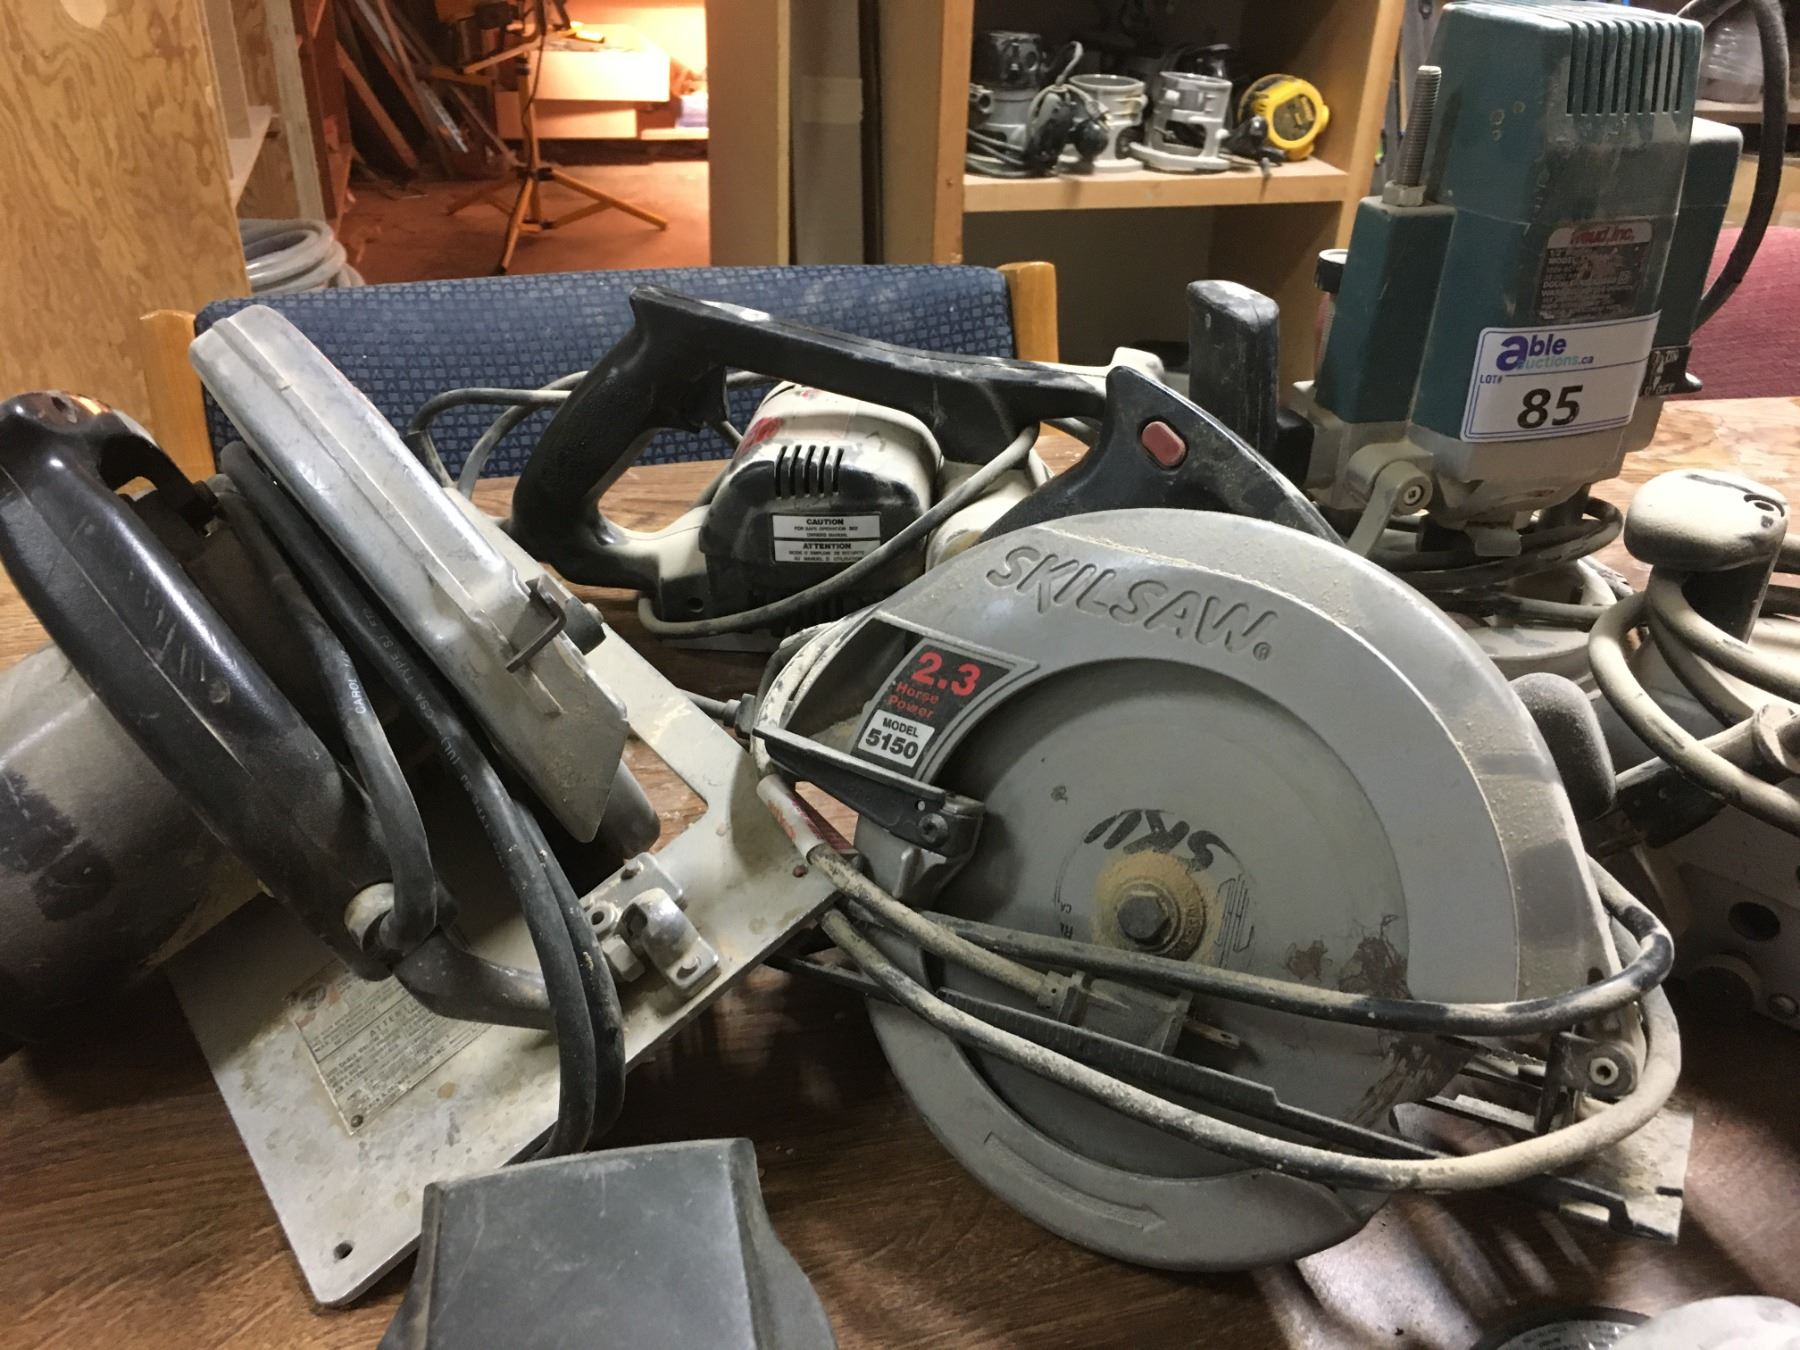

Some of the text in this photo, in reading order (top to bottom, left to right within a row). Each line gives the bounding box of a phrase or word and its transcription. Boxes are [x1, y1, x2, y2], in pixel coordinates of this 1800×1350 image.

[1496, 335, 1567, 371] able
[1480, 374, 1502, 384] LOT#
[1517, 385, 1583, 429] 85
[986, 545, 1278, 653] SKILSAW
[911, 652, 981, 696] 2.3
[888, 694, 934, 718] Power
[896, 682, 939, 704] Horse
[865, 728, 919, 759] 5150
[882, 718, 919, 738] MODEL
